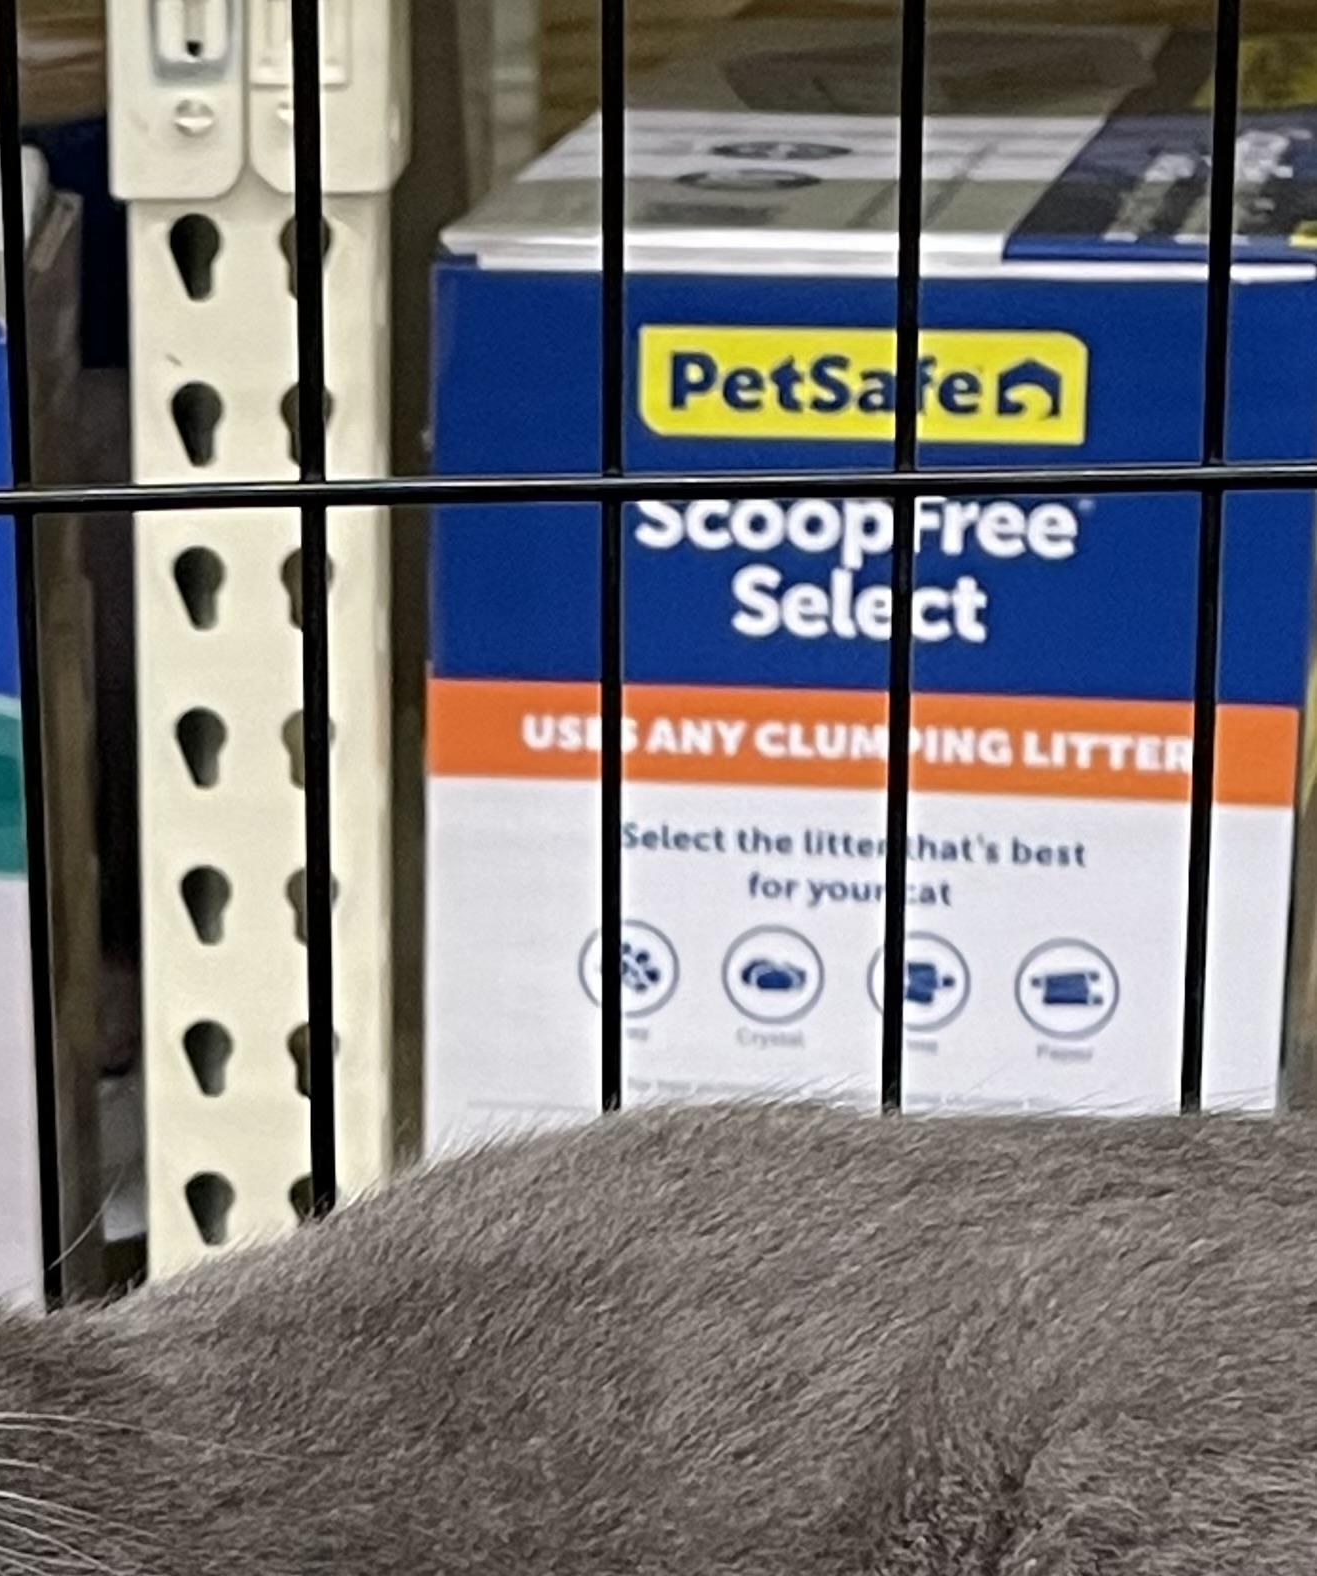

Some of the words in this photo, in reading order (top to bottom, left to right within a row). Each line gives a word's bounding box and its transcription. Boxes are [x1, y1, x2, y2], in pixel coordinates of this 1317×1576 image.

[669, 350, 982, 416] PetSafe
[635, 497, 1079, 570] ScoopFree
[731, 563, 988, 643] Select
[647, 717, 745, 757] ANY
[1023, 729, 1194, 774] LITTER
[623, 822, 725, 852] Select
[738, 826, 793, 855] the
[805, 828, 888, 858] litter
[1012, 836, 1087, 868] best
[749, 870, 798, 899] for
[808, 878, 885, 908] your
